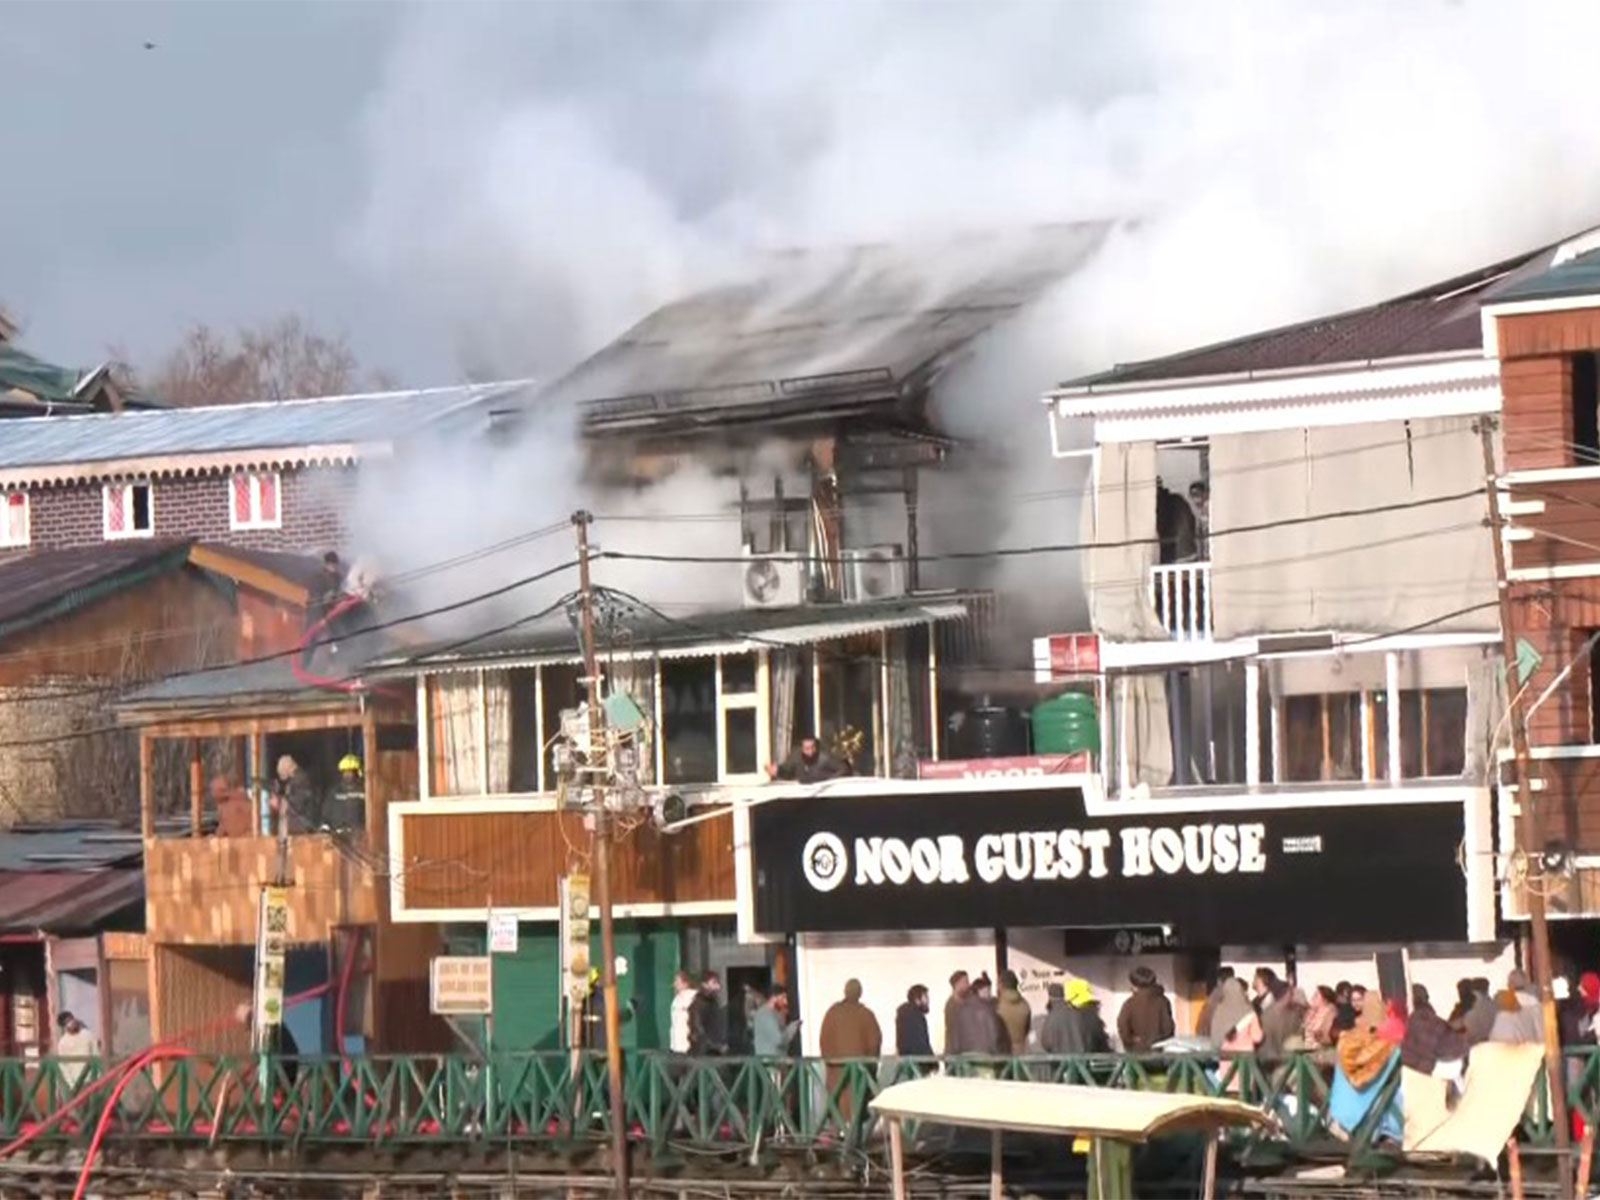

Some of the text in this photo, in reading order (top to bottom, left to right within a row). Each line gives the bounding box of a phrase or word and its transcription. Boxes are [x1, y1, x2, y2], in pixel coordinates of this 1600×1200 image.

[854, 823, 1267, 886] NOOR GUEST HOUSE
